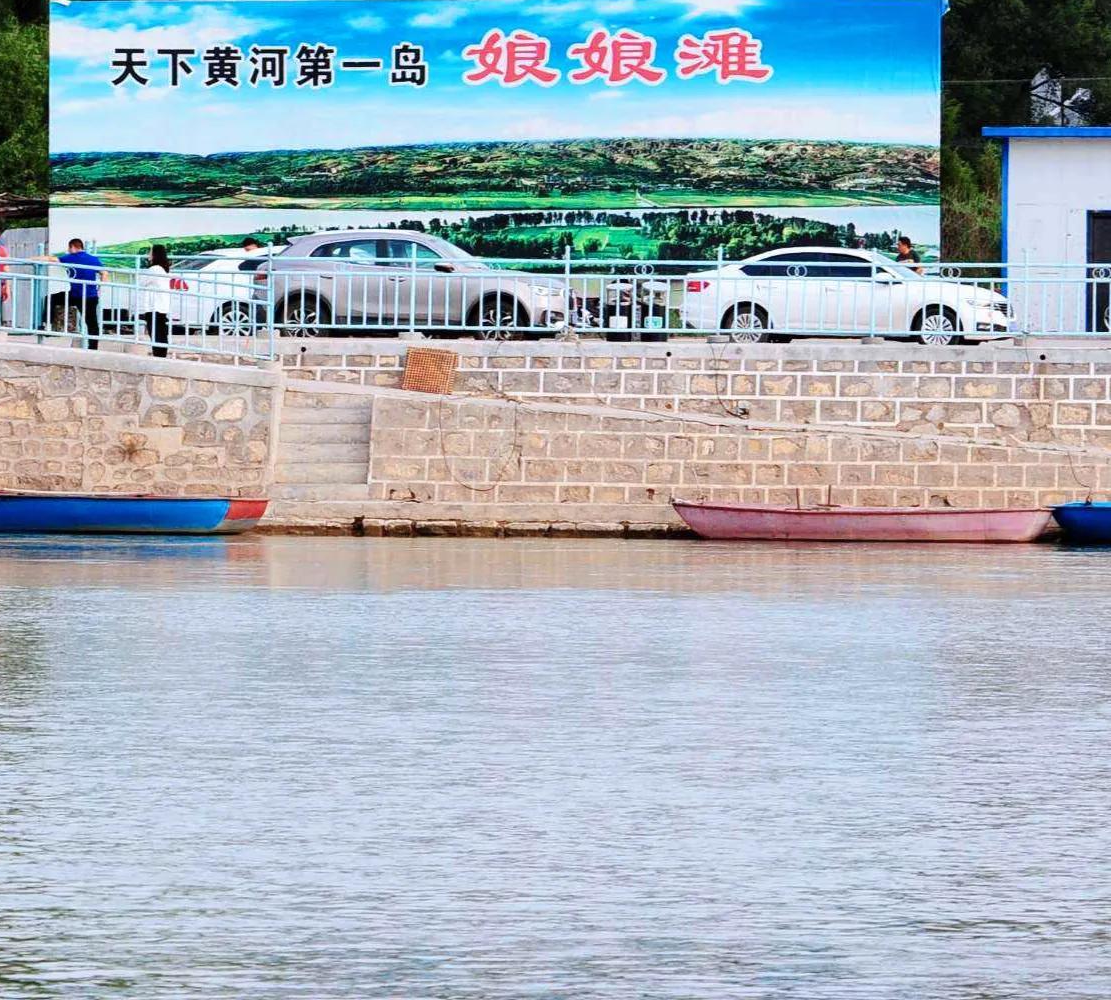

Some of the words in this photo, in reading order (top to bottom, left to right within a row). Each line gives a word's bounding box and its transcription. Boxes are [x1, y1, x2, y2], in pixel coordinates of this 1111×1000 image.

[111, 44, 427, 87] 天下黄河第一岛
[465, 30, 771, 84] 娘娘滩
